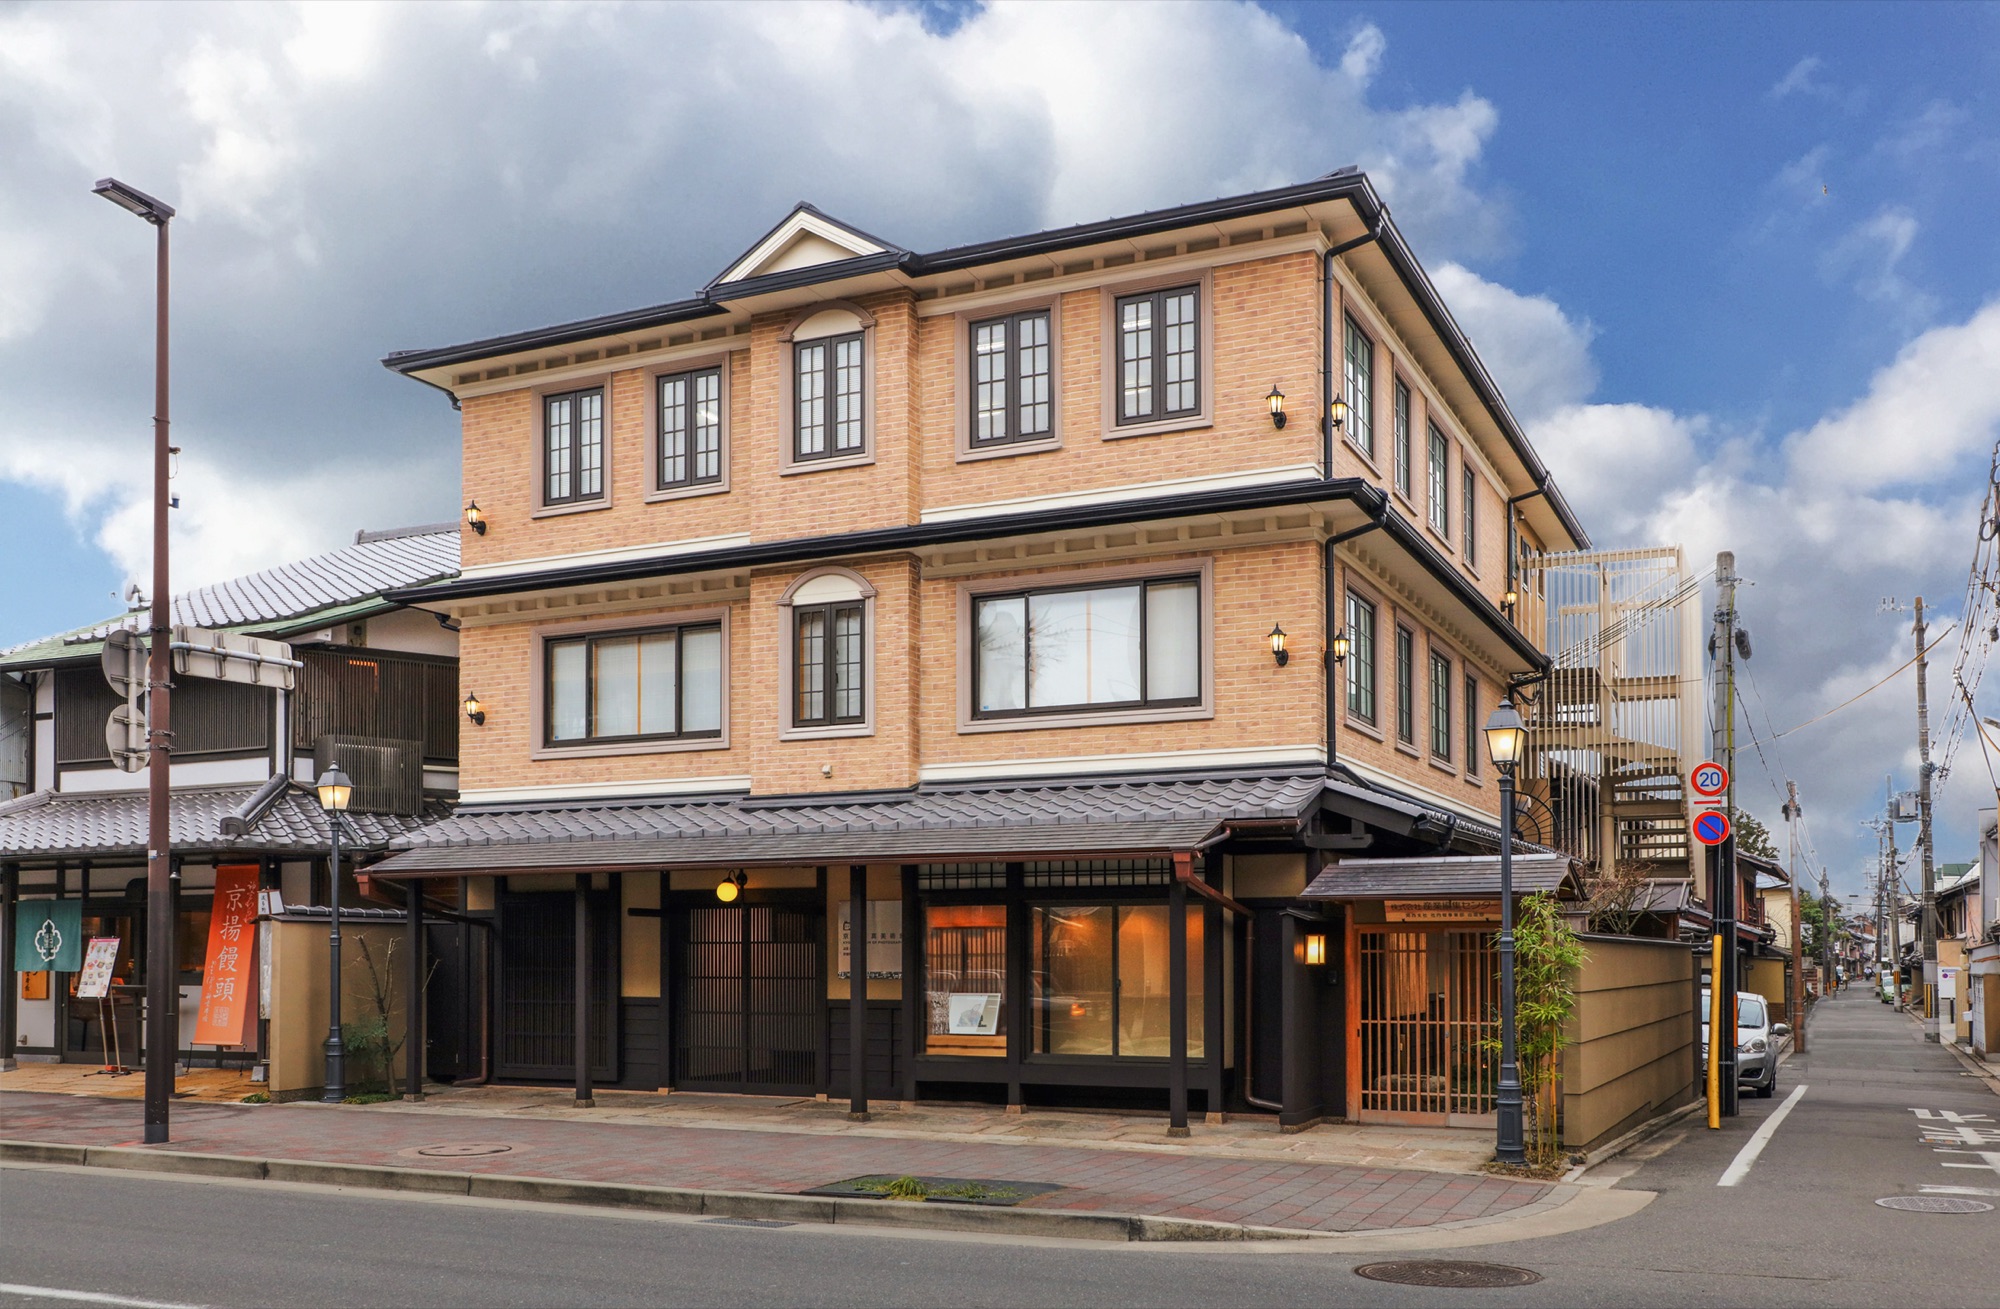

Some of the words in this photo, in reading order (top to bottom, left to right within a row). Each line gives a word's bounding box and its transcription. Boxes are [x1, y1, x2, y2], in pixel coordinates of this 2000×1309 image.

[1699, 771, 1720, 787] 20
[213, 884, 246, 1002] 京揚饅頭
